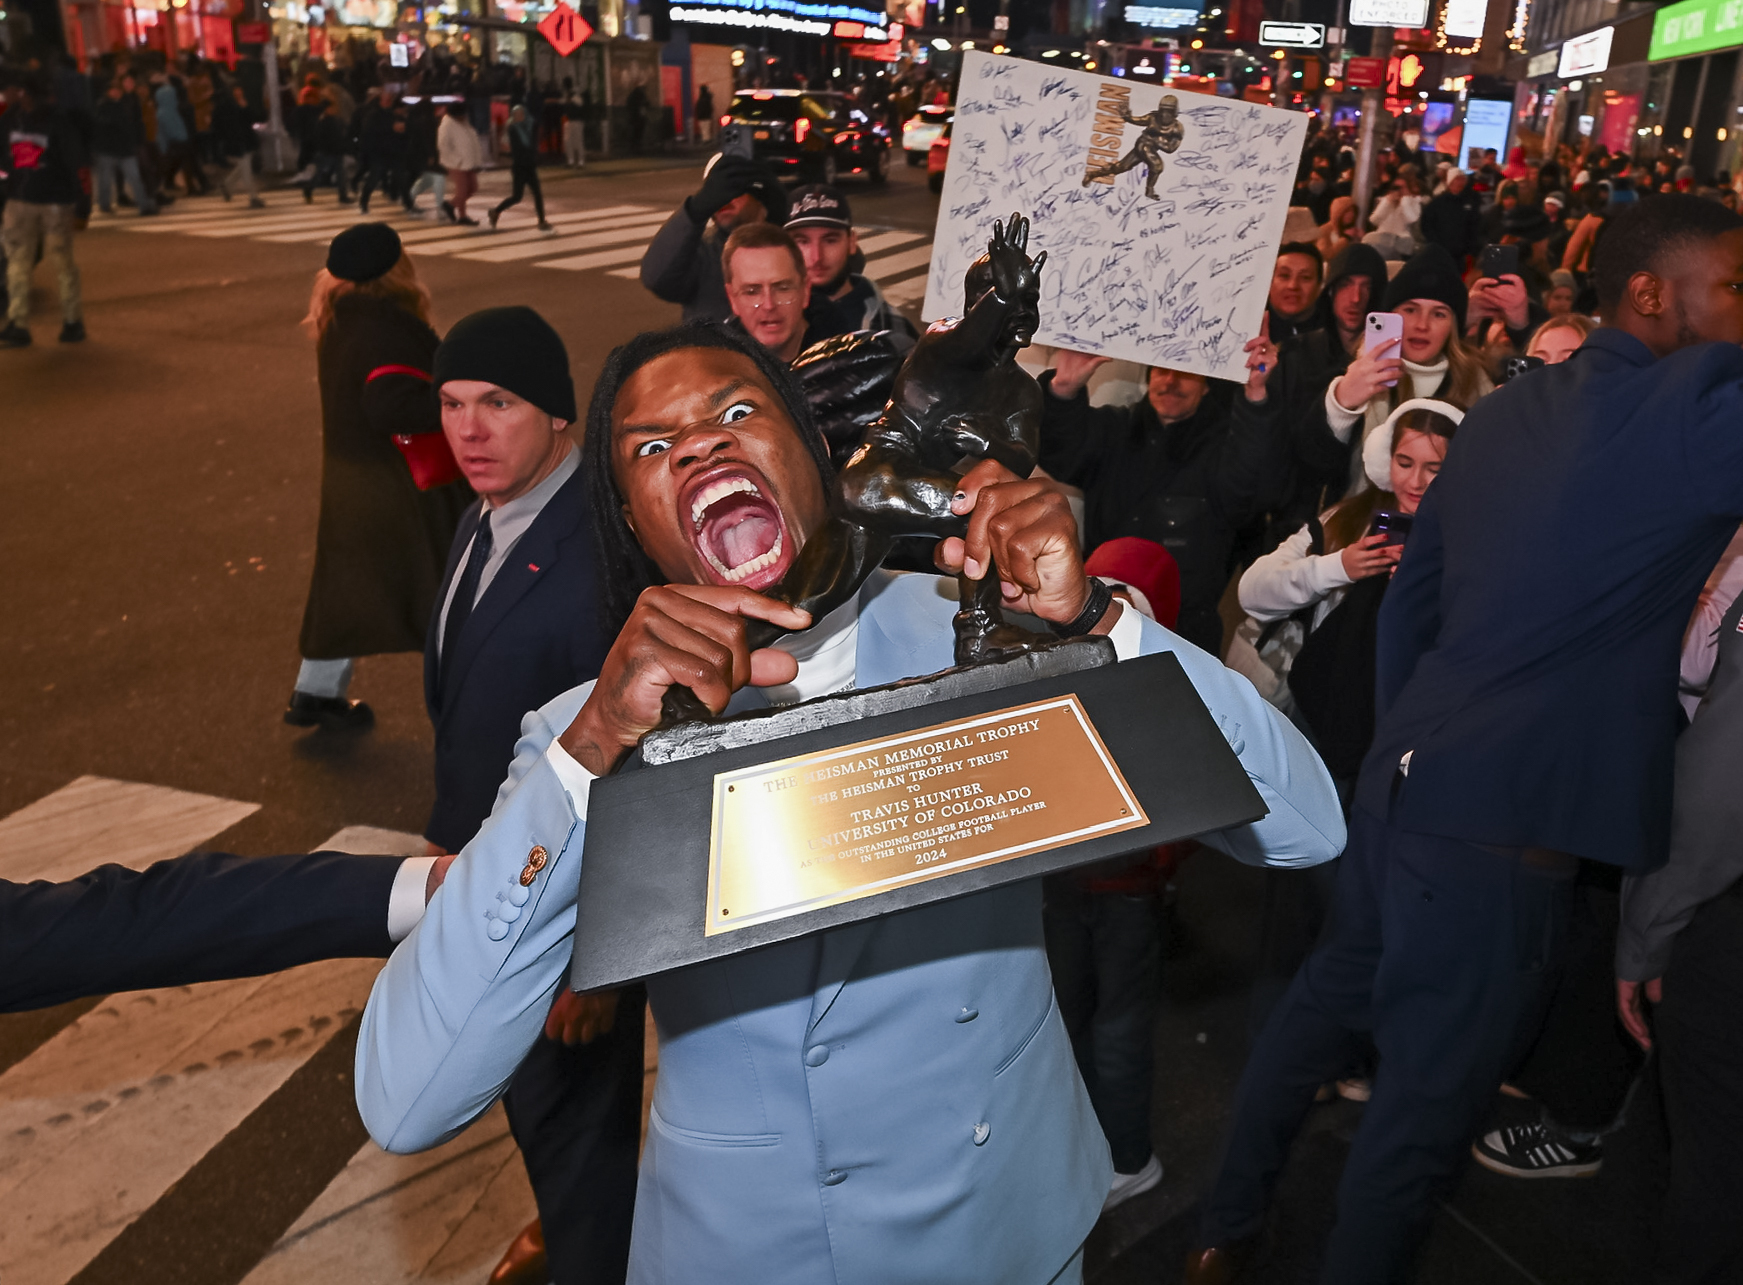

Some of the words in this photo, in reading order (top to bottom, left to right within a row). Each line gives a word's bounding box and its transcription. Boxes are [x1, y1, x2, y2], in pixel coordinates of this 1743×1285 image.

[763, 775, 798, 793] THE
[804, 756, 880, 785] HEISMAN
[884, 735, 974, 765] MEMORIAL
[976, 719, 1040, 744] TROPHY
[872, 758, 928, 778] PRESENTED
[930, 755, 943, 765] BY
[810, 791, 838, 806] THE
[842, 775, 906, 799] HEISMAN
[909, 760, 964, 782] TROPHY
[967, 750, 1010, 768] TRUST
[906, 785, 921, 793] TO
[807, 816, 909, 850] UNIVERSITY
[915, 810, 936, 824] OF
[941, 786, 1032, 818] COLORADO
[850, 801, 910, 823] TRAVIS
[913, 782, 984, 809] HUNTER
[800, 860, 812, 868] AS
[838, 836, 910, 859] OUTSTANDING
[912, 823, 956, 841] COLLEGE
[959, 811, 1009, 828] FOOTBALL
[1010, 801, 1047, 816] PLAYER
[861, 855, 872, 863] IN
[874, 849, 894, 860] THE
[897, 839, 936, 854] UNITED
[938, 830, 972, 844] STATES
[975, 823, 994, 835] FOR
[915, 848, 948, 865] 2024
